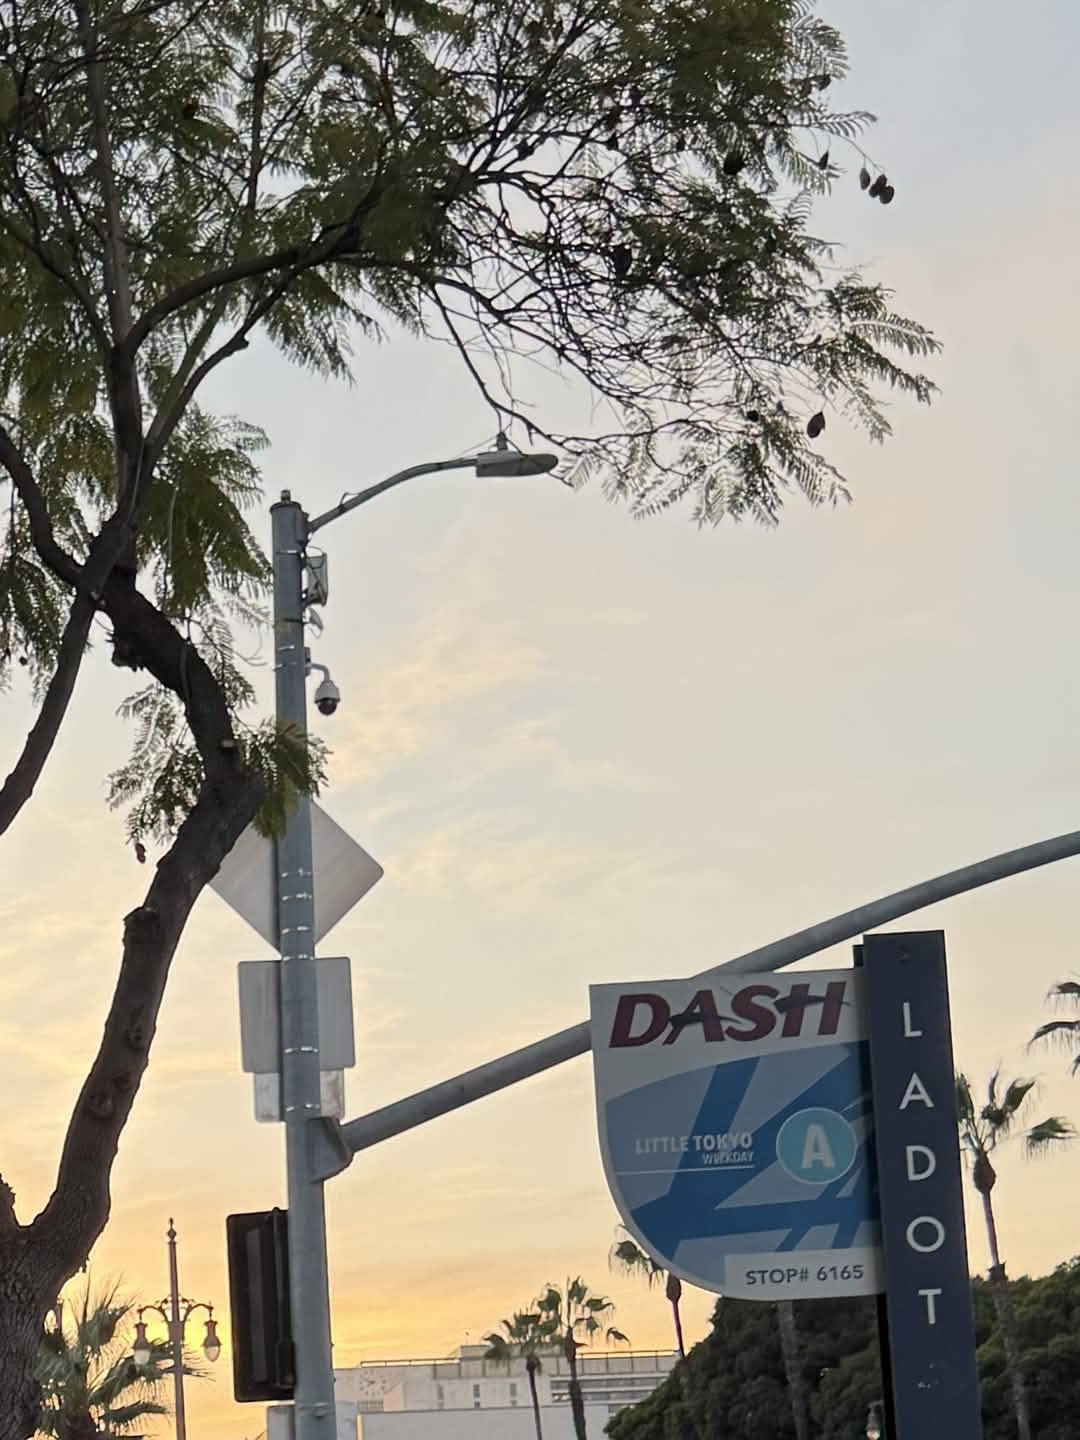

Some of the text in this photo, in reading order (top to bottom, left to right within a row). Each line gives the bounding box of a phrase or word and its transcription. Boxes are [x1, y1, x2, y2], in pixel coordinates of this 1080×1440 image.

[608, 980, 849, 1049] DASH
[635, 1132, 753, 1155] LITTLE TOKYO
[801, 1124, 835, 1169] A
[745, 1264, 865, 1286] STOP# 6165
